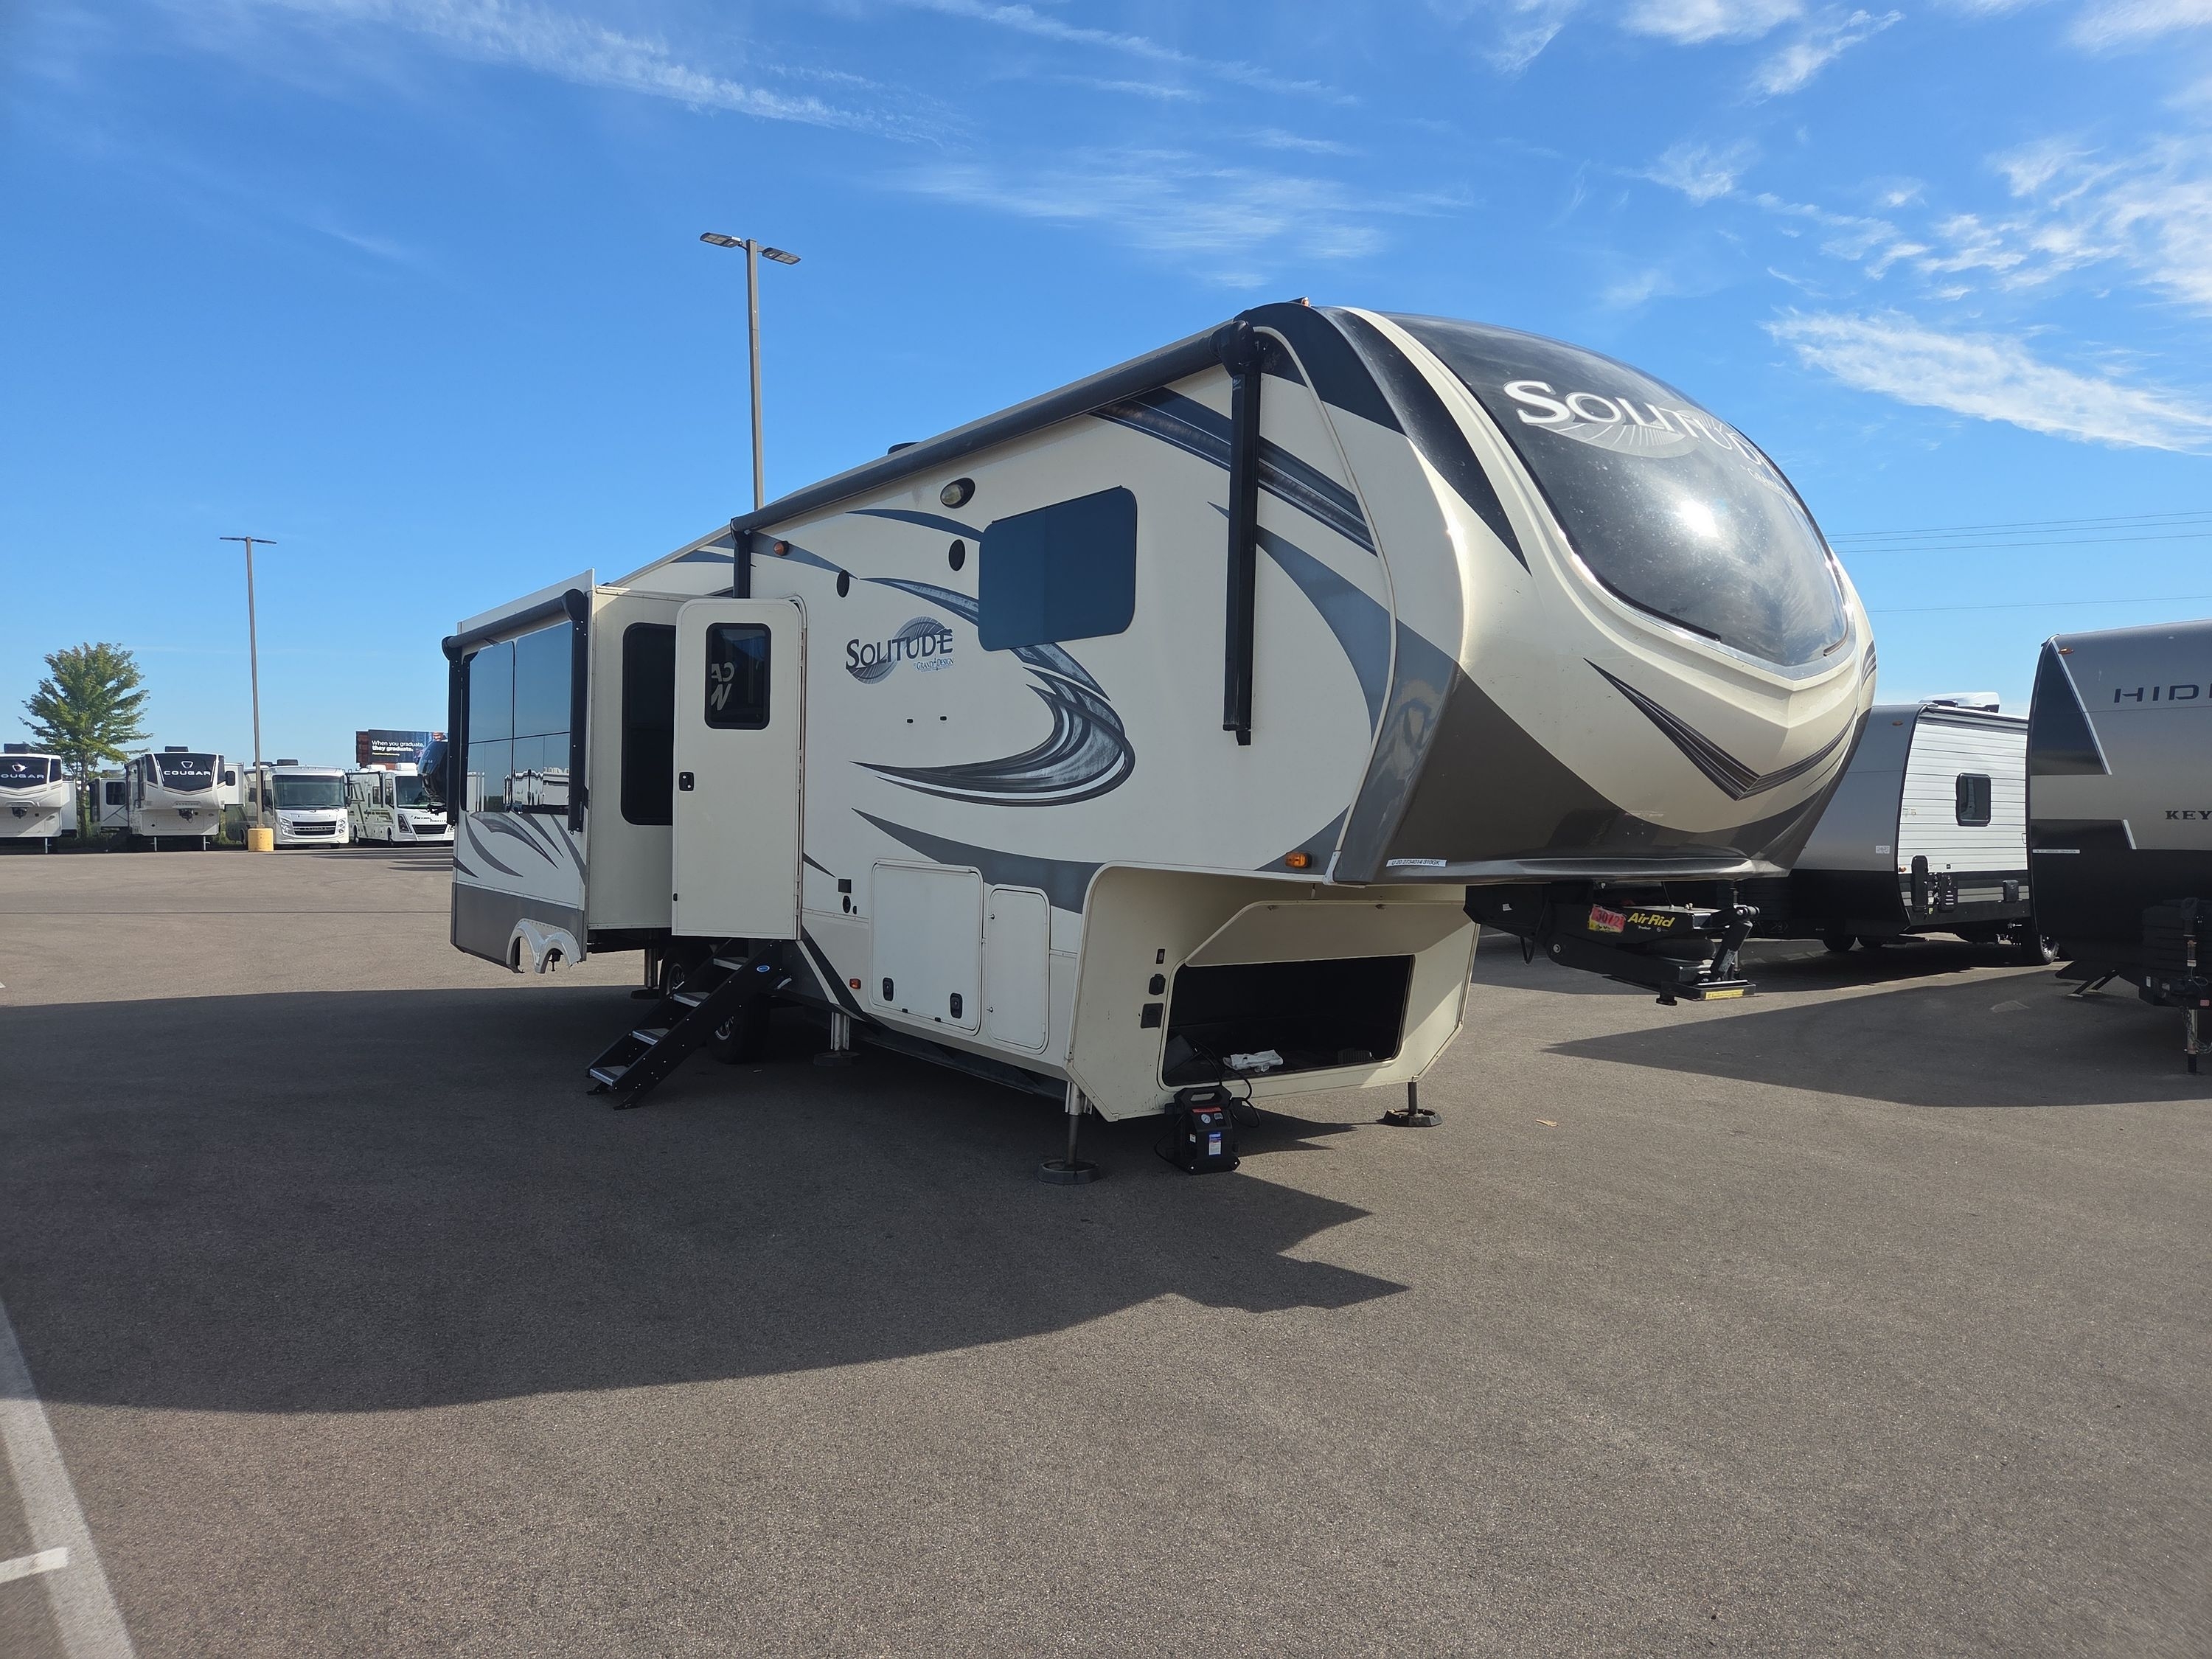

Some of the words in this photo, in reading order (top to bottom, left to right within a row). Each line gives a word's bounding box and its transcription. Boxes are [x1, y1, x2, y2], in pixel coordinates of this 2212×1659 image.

[846, 628, 953, 669] SOLITUDE
[2114, 683, 2212, 703] HID
[2165, 810, 2212, 820] KEY
